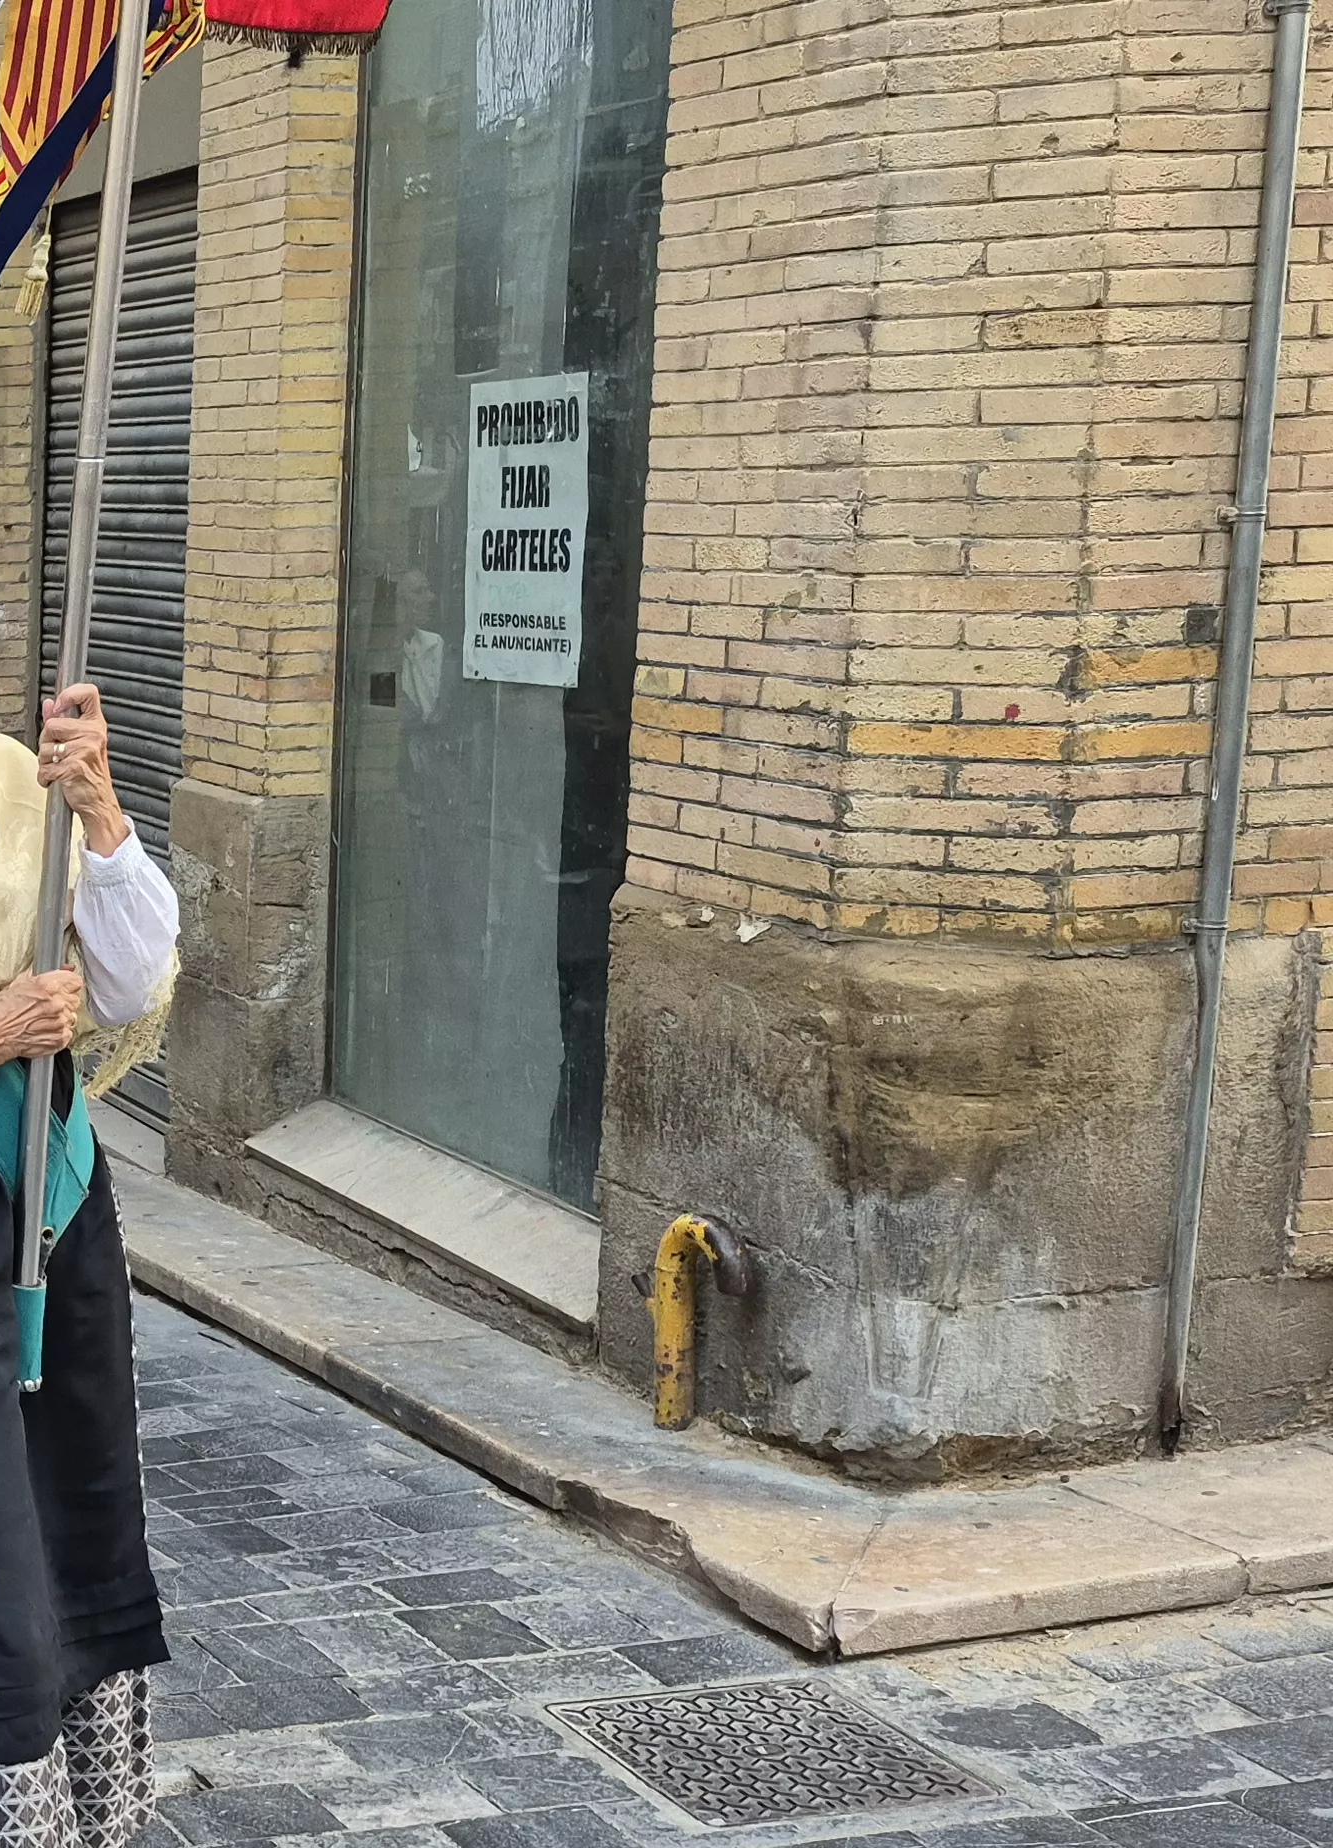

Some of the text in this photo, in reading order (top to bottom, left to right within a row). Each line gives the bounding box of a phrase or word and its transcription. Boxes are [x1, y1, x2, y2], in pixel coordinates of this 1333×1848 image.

[477, 396, 580, 447] PROHIBIDO
[501, 464, 550, 509] FIJAR
[481, 528, 572, 573] CARTELES
[479, 612, 567, 631] (RESPONSABLE
[474, 634, 572, 658] EL ANUNCIANTE)
